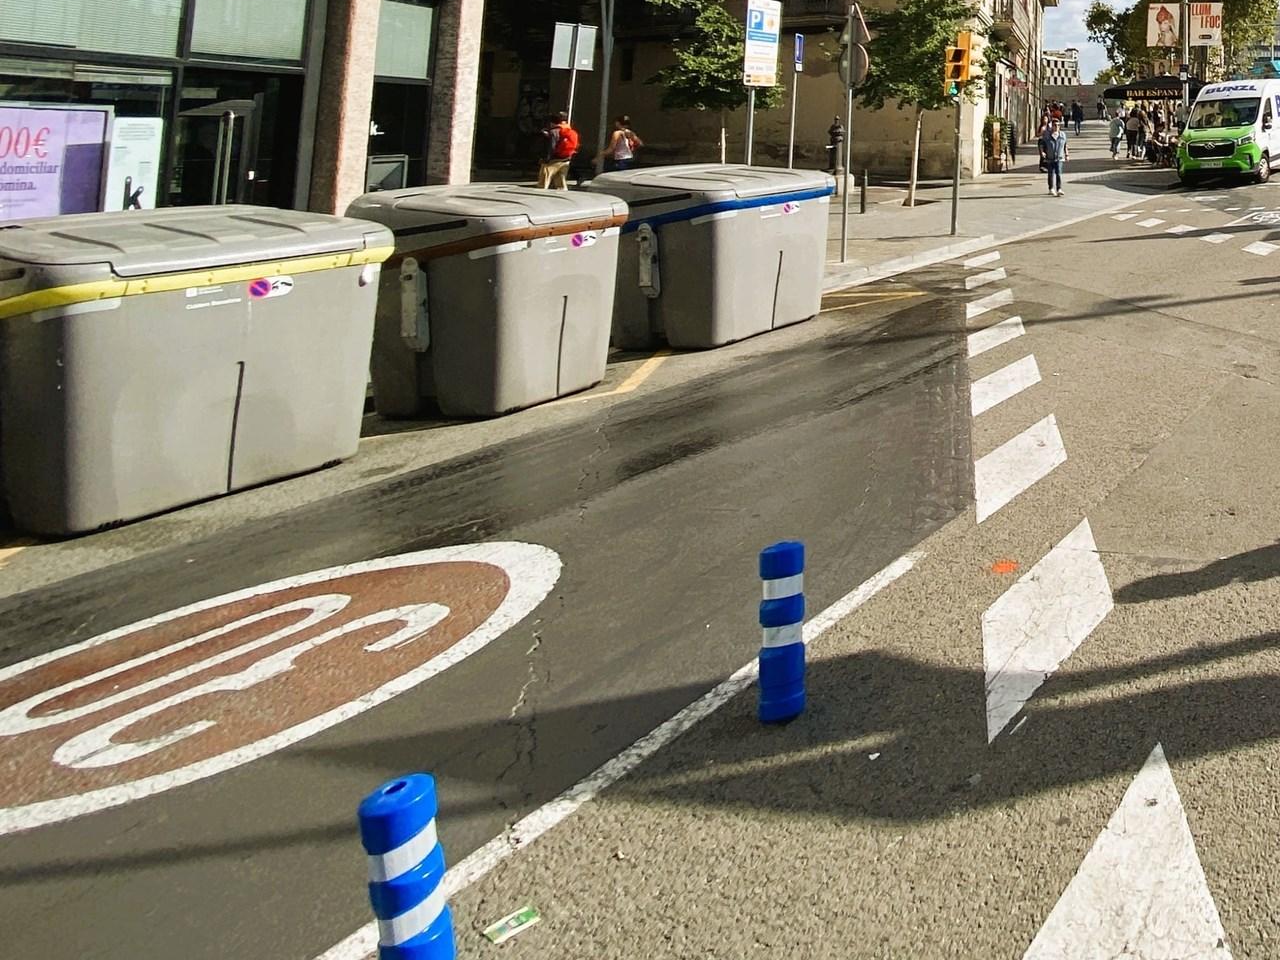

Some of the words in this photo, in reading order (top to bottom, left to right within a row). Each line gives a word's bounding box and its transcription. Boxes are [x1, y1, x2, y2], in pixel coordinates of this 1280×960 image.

[1191, 3, 1212, 16] LLUM
[1205, 15, 1221, 29] FOC
[1126, 89, 1145, 97] BAR
[1205, 84, 1257, 95] BUNZL
